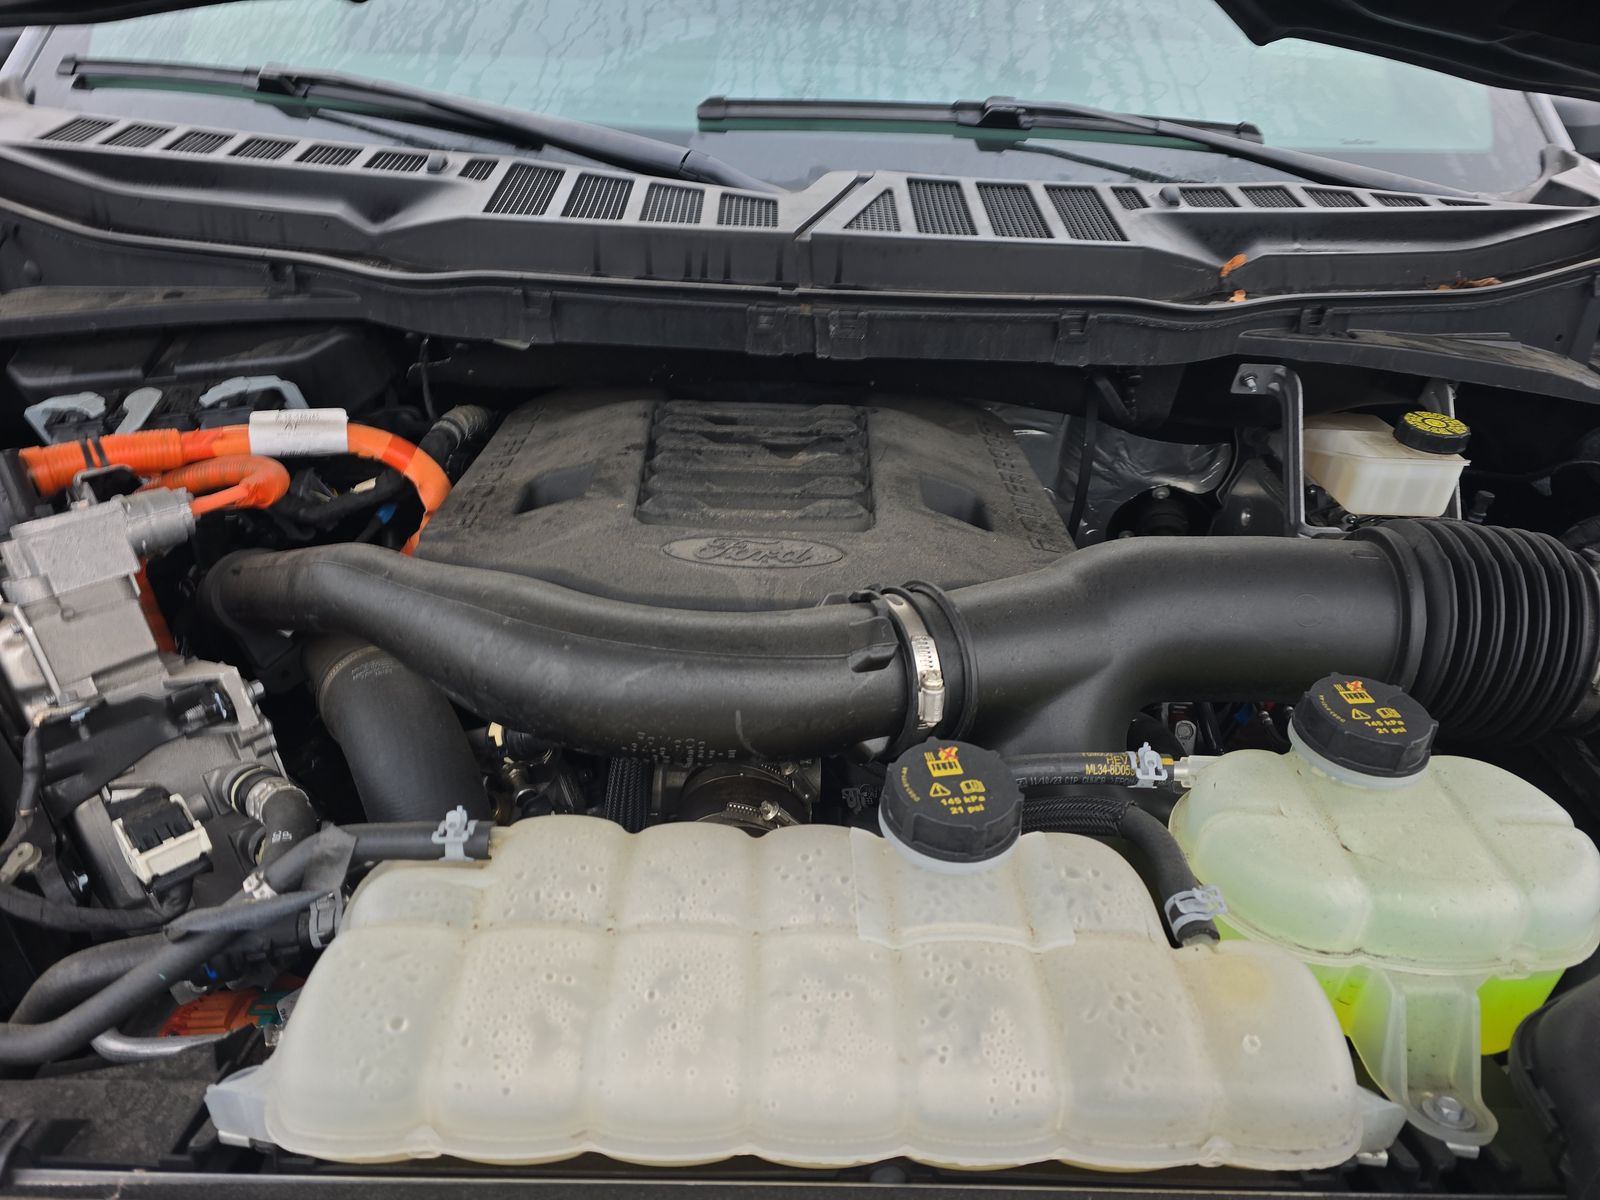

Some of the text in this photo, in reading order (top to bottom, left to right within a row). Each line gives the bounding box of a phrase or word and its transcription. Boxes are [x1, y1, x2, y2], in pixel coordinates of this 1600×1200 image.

[694, 537, 815, 564] Ford
[1383, 719, 1405, 727] kPa
[1391, 726, 1408, 735] psi
[1106, 754, 1128, 765] HEV
[940, 795, 986, 806] 145 kPa
[949, 803, 985, 815] 21 psi
